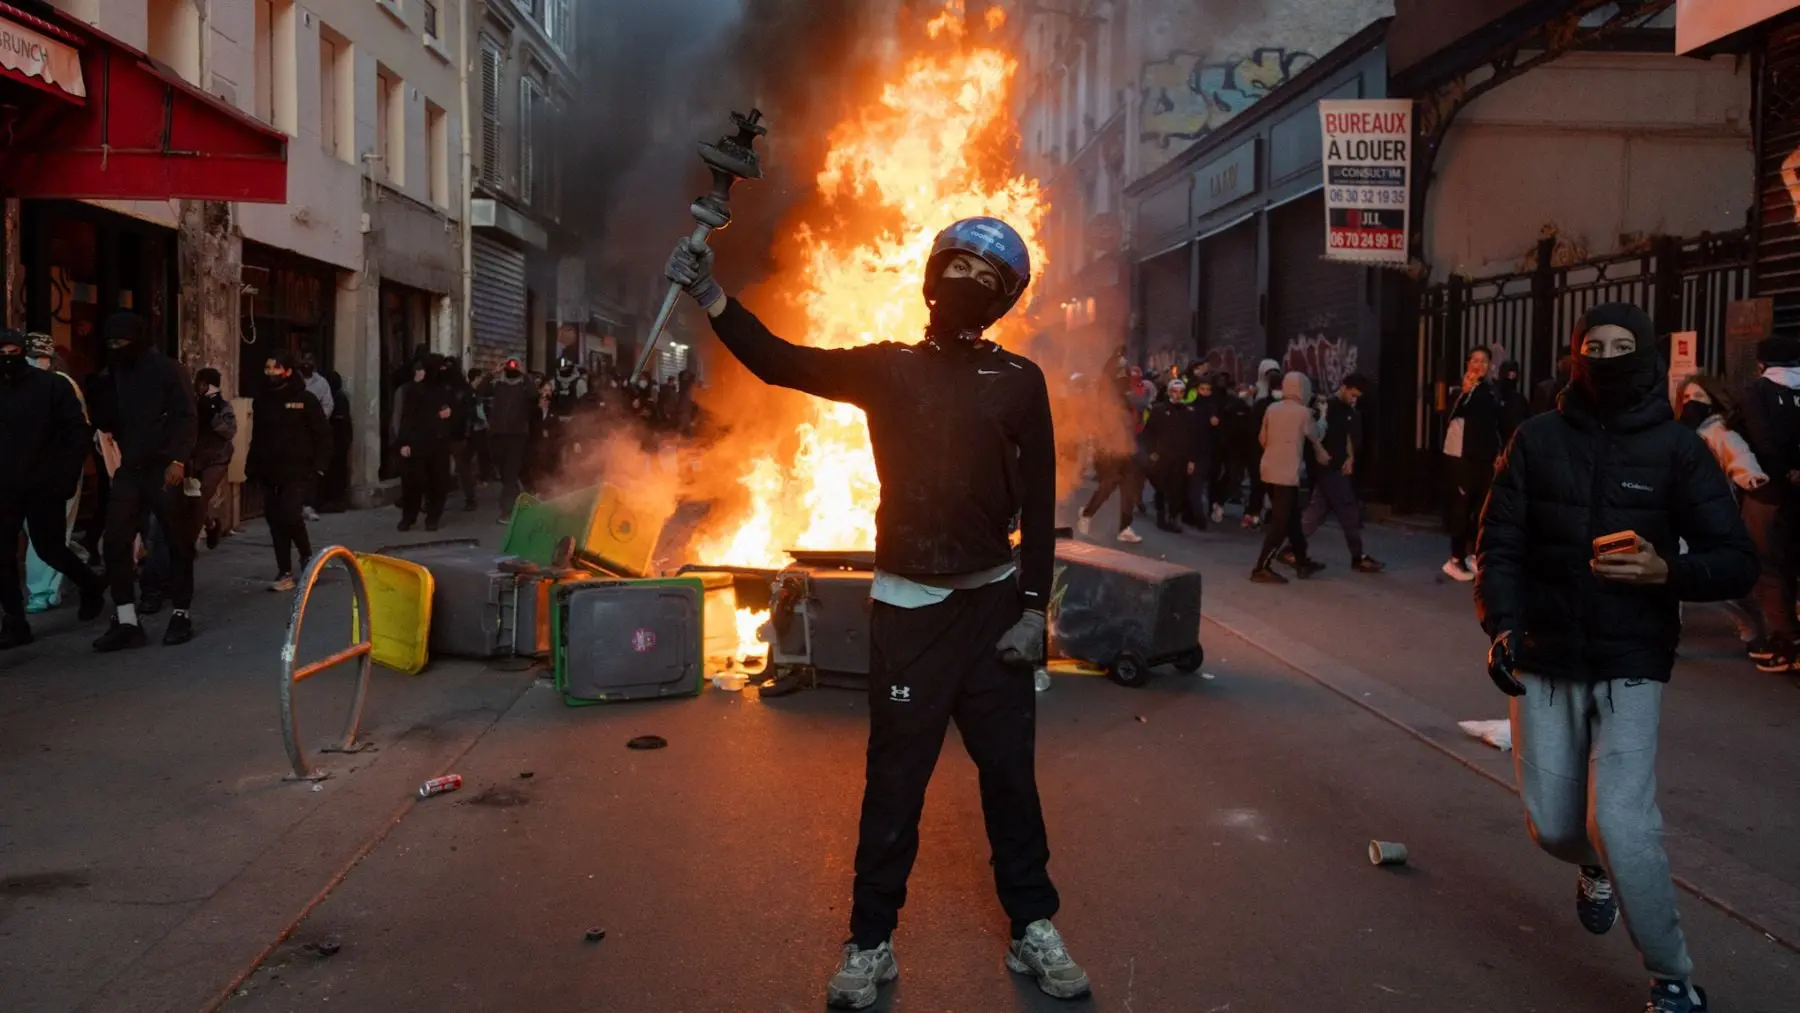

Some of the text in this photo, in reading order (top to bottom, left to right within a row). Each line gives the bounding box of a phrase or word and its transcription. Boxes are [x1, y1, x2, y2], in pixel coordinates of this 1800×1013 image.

[0, 31, 49, 62] RUNCH
[1325, 112, 1407, 134] BUREAUX
[1328, 135, 1406, 161] À LOUER
[1330, 188, 1405, 204] 06 30 32 19 35
[1361, 212, 1382, 225] JLL
[1330, 231, 1404, 248] 06 70 24 99 12
